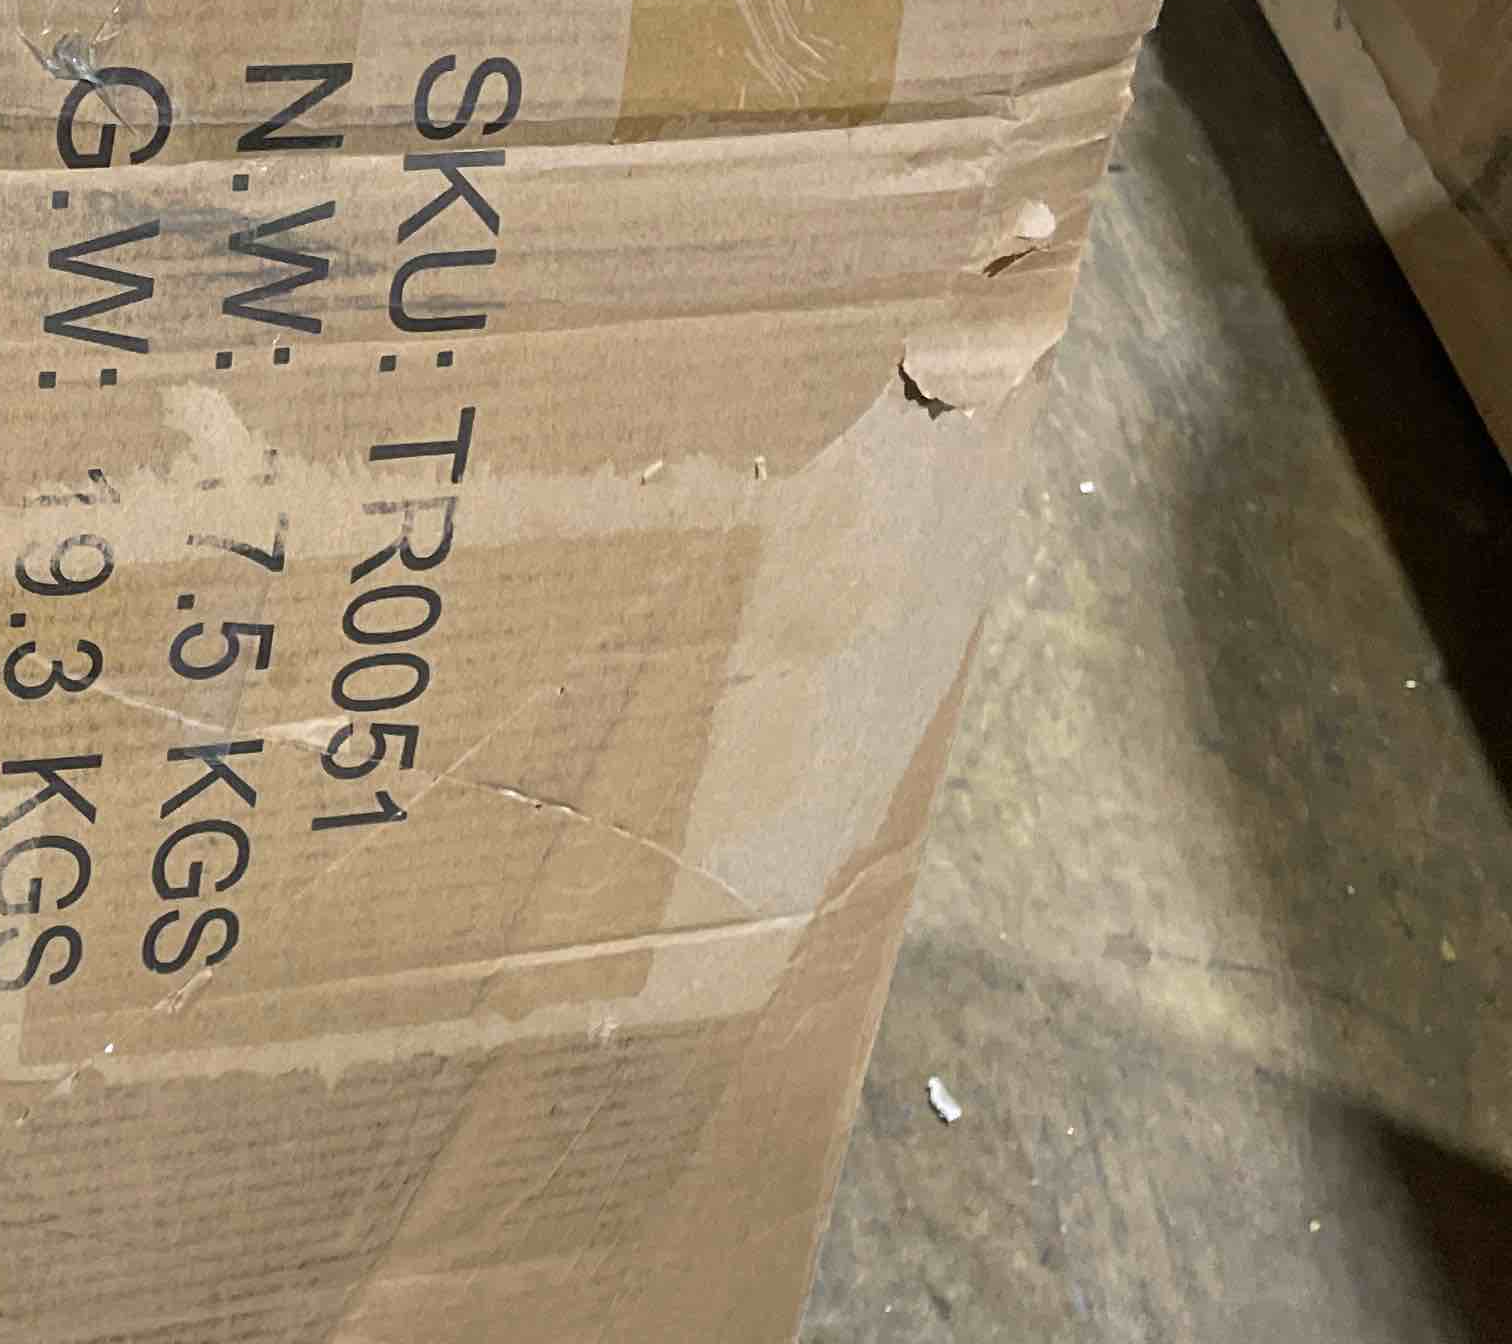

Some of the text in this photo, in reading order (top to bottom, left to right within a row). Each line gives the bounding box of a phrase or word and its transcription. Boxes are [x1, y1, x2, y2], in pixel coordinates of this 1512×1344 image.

[311, 53, 523, 831] SKU: TR0051
[141, 738, 265, 975] KGS
